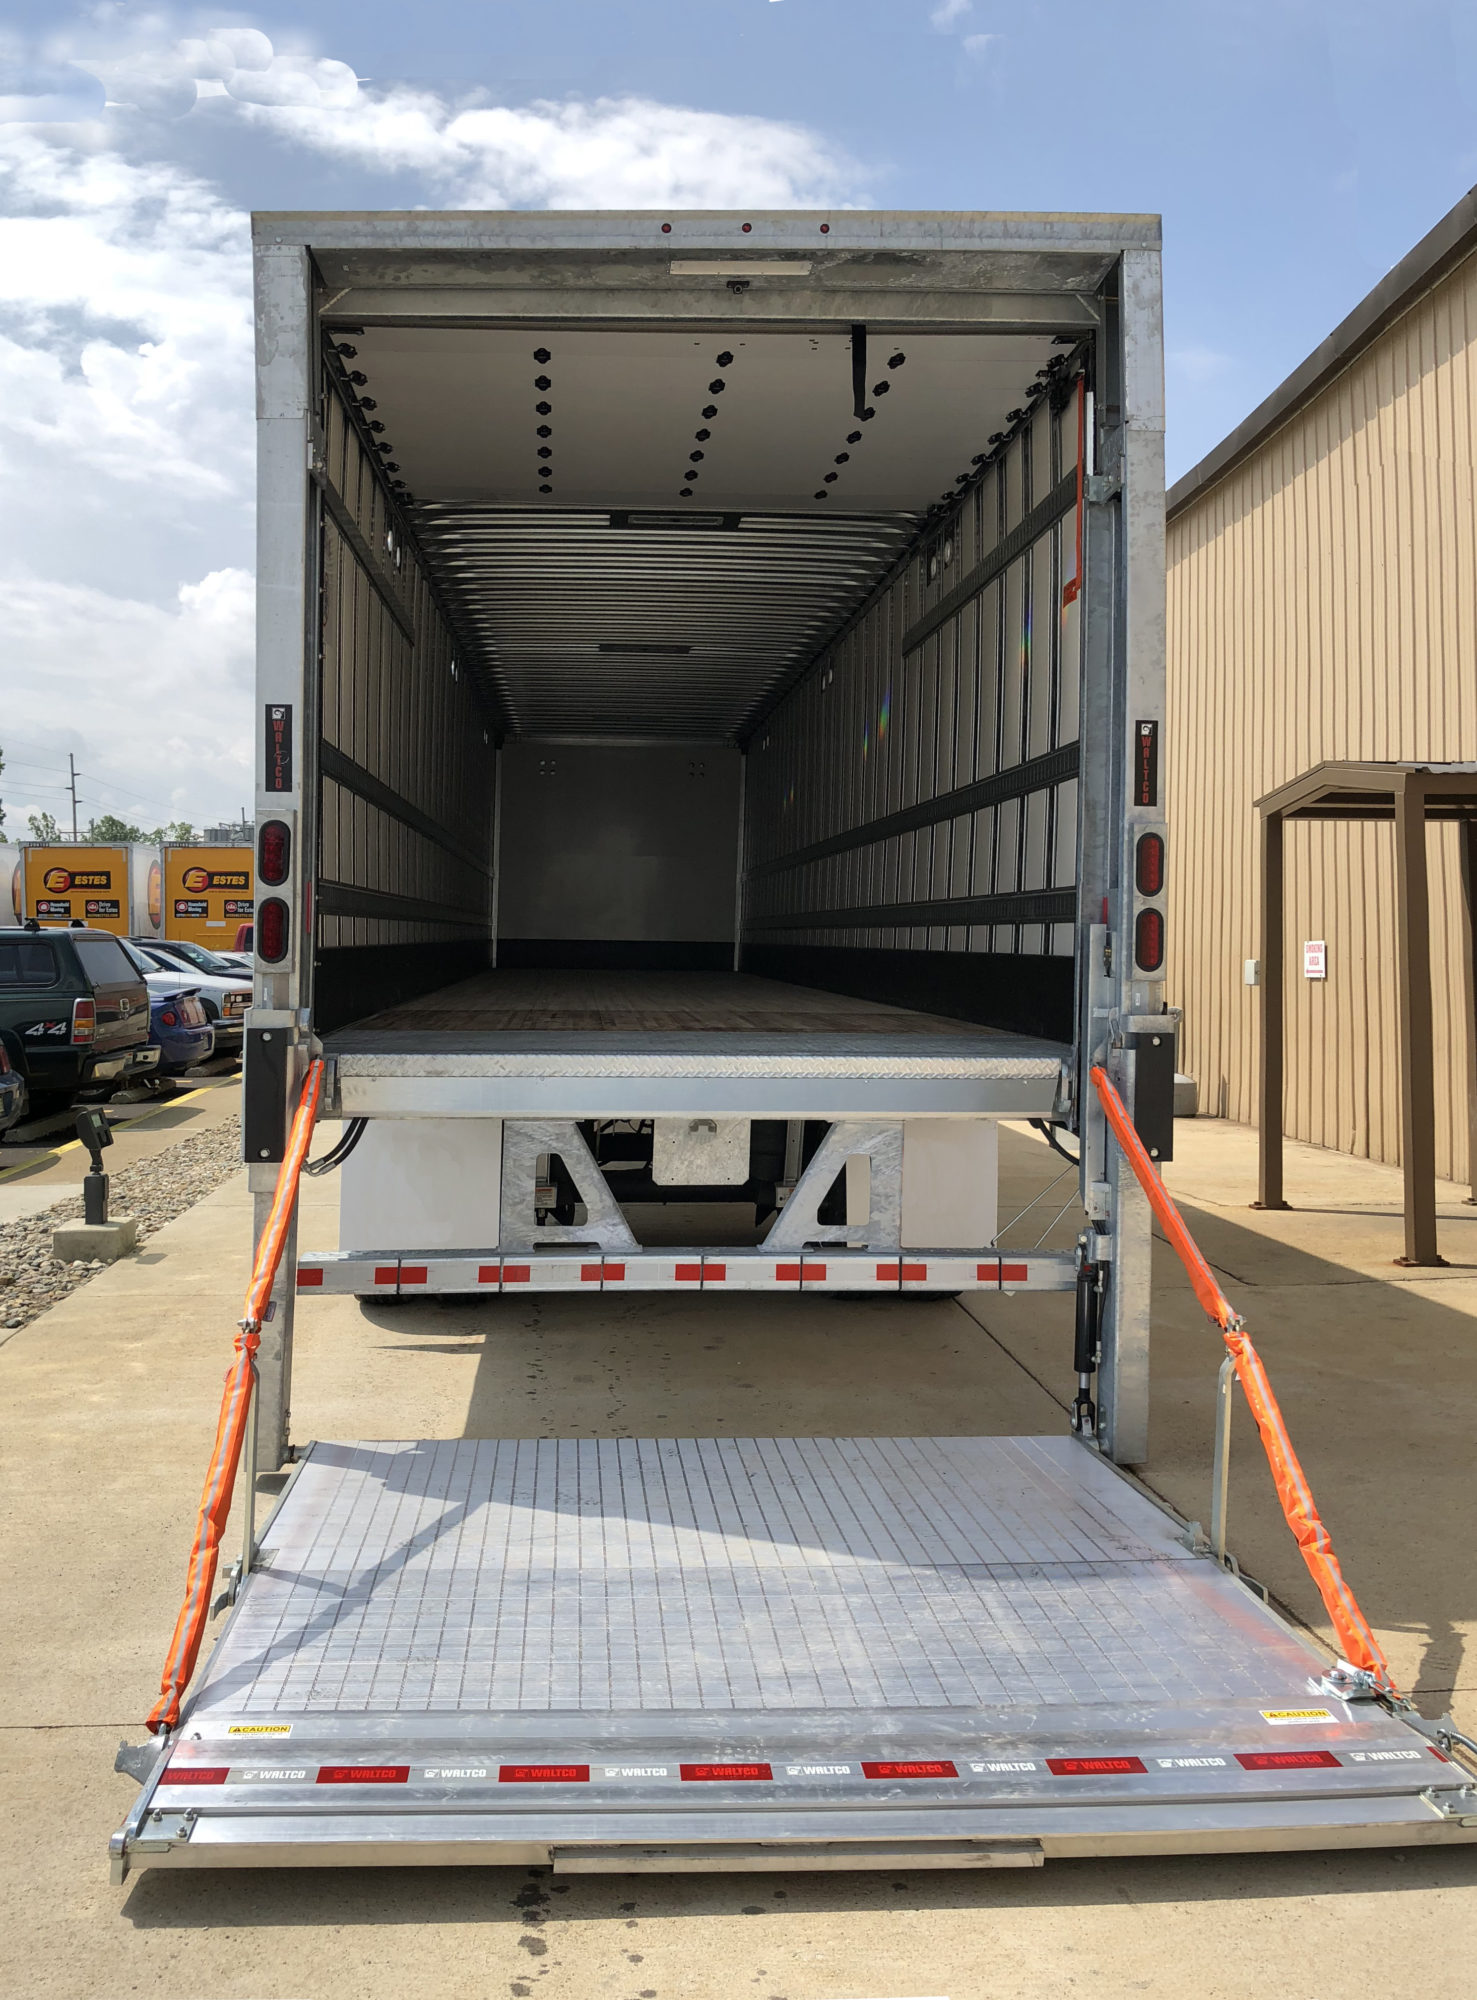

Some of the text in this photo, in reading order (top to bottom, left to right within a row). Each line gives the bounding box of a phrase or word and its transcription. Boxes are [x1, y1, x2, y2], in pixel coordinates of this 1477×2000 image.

[272, 720, 285, 789] WALTCO
[1141, 736, 1152, 804] WALTCO
[74, 875, 107, 885] ESTES
[212, 875, 246, 885] ESTES
[168, 1751, 1422, 1780] WALTCO WALTCO WALTCO WALTCO WALTCO WALTCO WALTCO WALTCO WALTCO WALTCO WALTCO WALTCO WALTCO WALTCO
